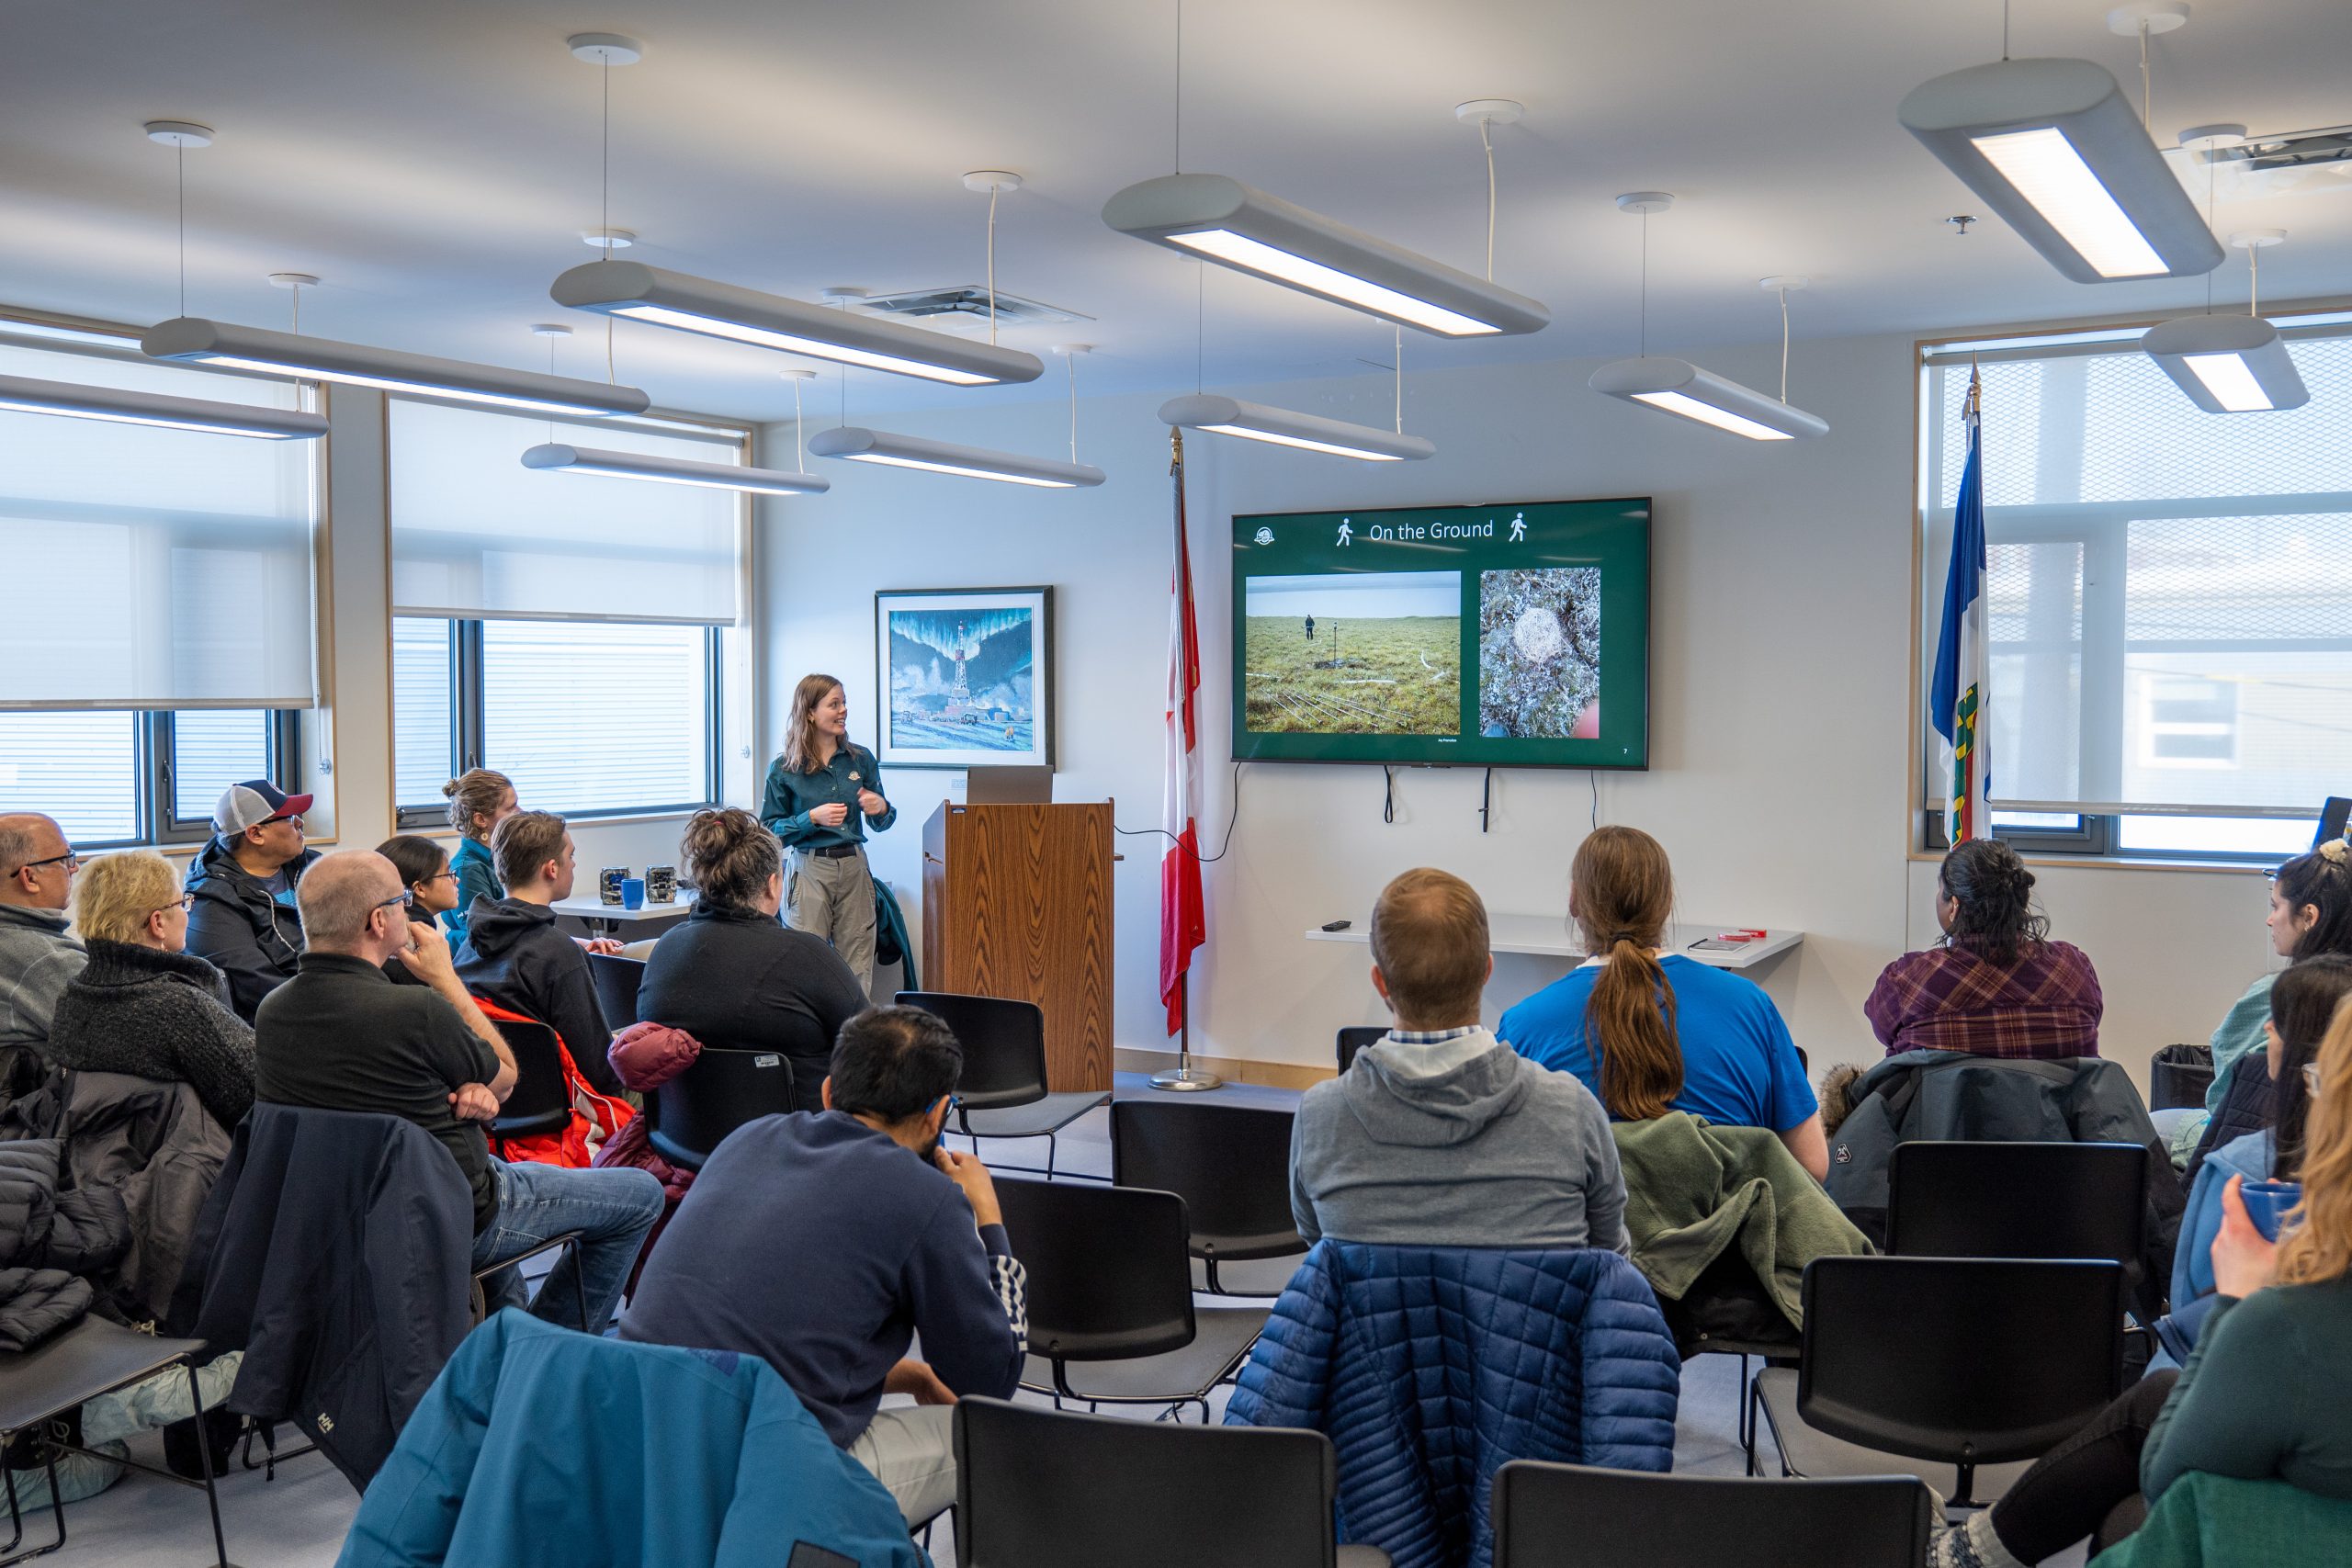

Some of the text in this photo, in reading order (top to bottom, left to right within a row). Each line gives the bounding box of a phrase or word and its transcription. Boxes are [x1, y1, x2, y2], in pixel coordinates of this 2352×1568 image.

[1370, 519, 1493, 541] On the Ground
[317, 1412, 334, 1431] HH
